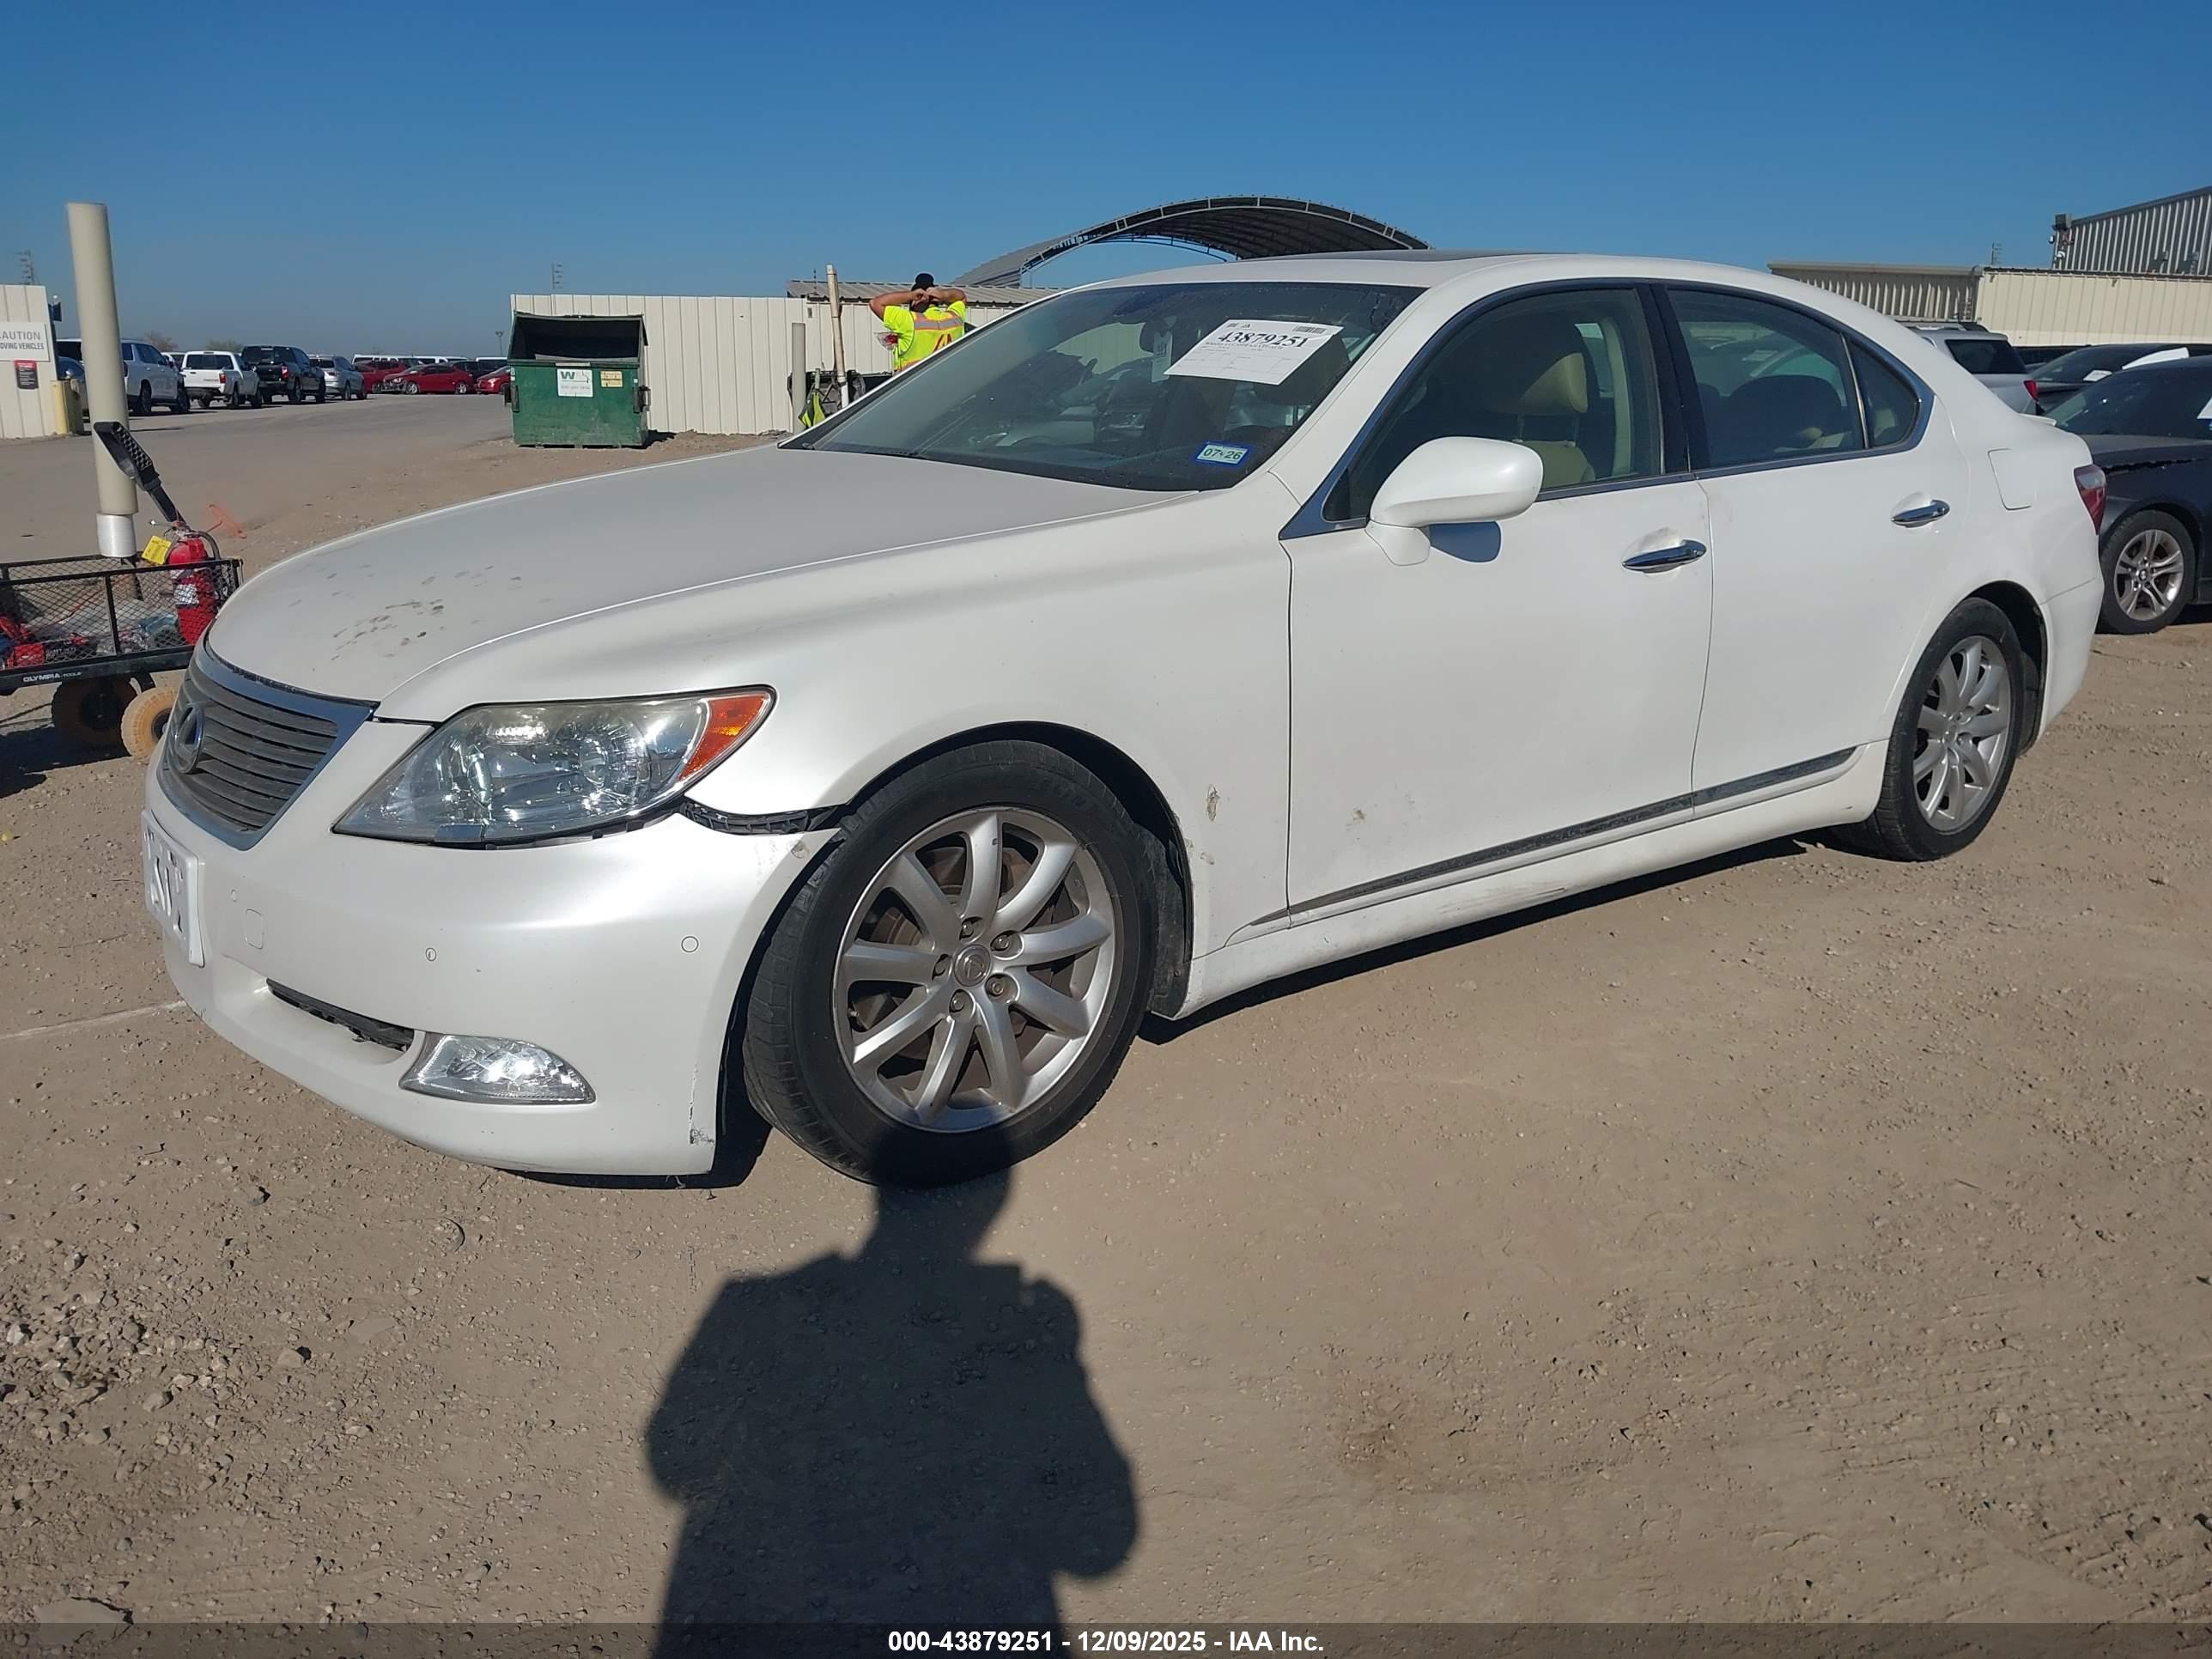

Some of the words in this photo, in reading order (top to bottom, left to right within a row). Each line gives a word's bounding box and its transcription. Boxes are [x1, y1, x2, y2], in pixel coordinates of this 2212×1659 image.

[0, 331, 41, 340] AUTION
[1218, 331, 1310, 348] 43879251
[0, 342, 18, 350] OVING
[22, 672, 61, 683] OLYMPIA
